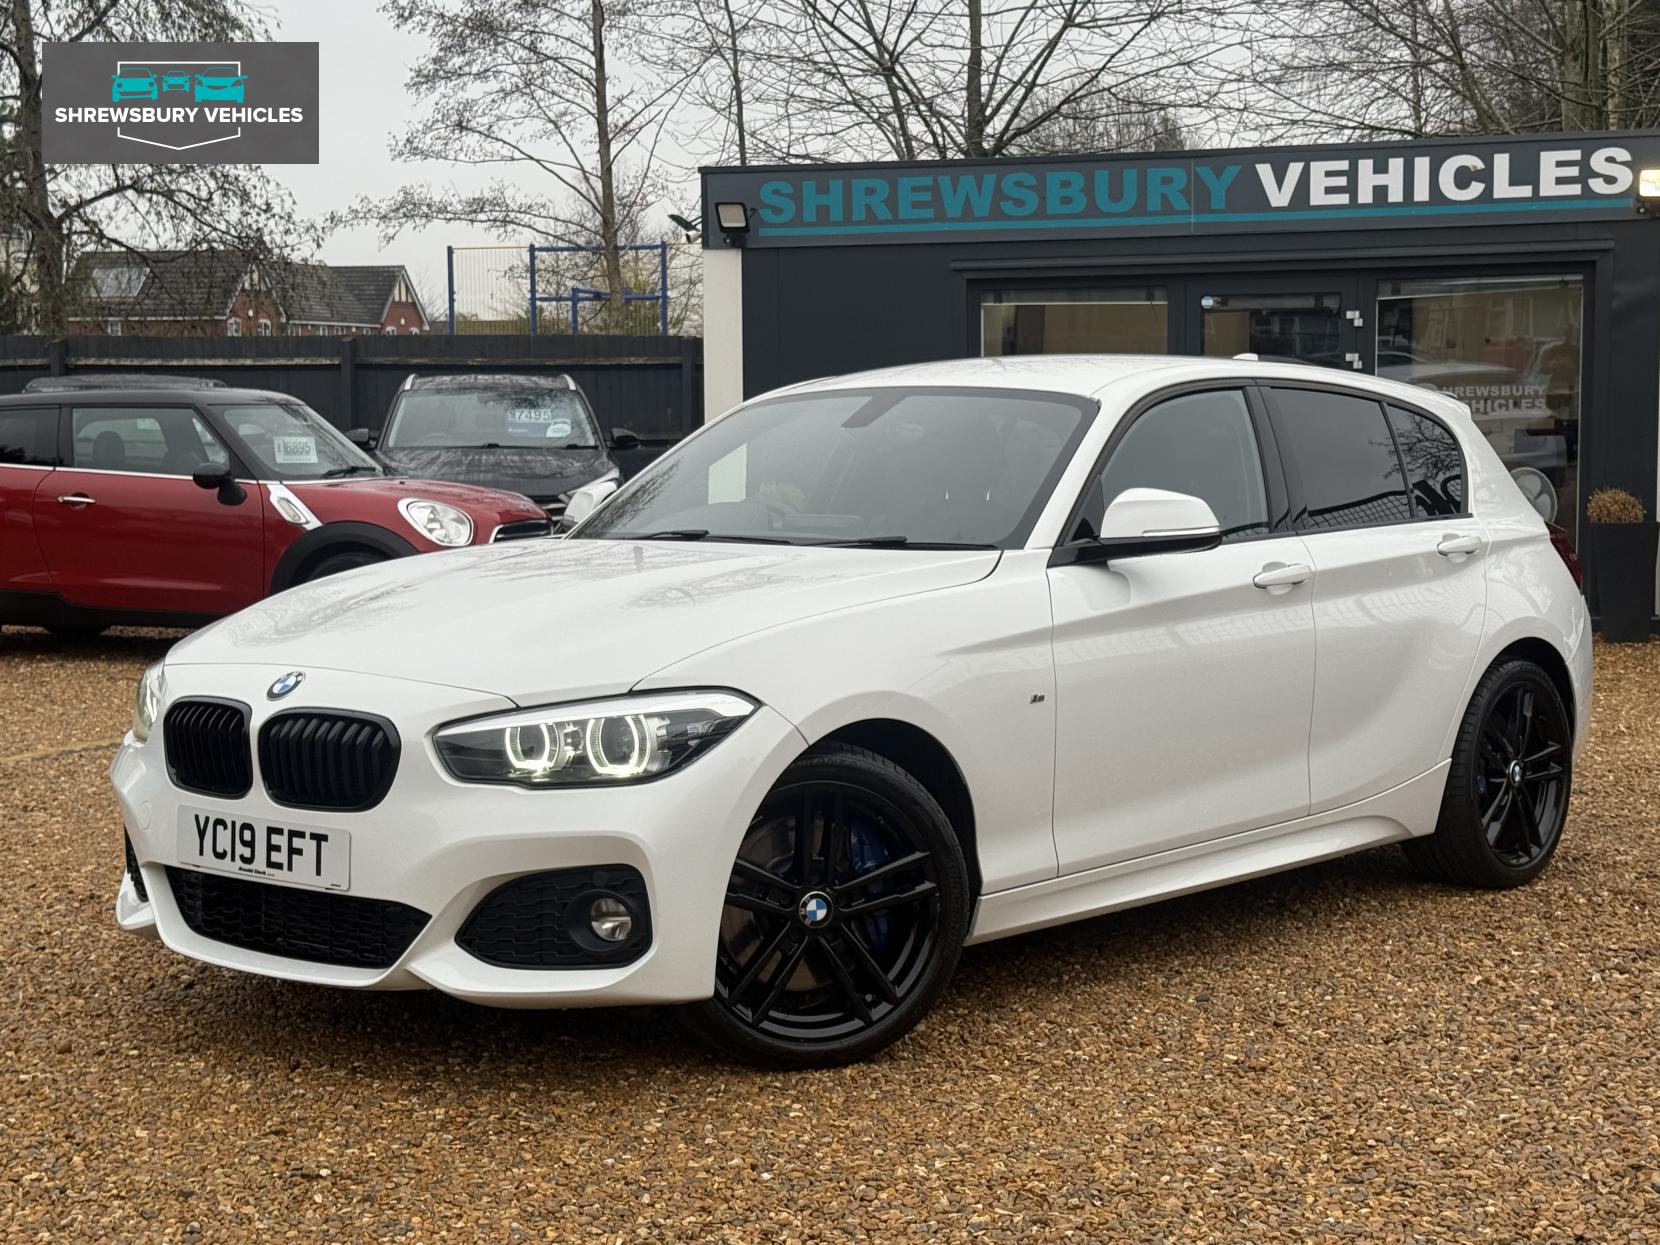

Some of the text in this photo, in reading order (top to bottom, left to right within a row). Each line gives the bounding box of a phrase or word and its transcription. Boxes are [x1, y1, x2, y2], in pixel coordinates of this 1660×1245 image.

[759, 146, 1633, 225] SHREWSBURY VEHICLES
[194, 814, 329, 877] YC19 EFT
